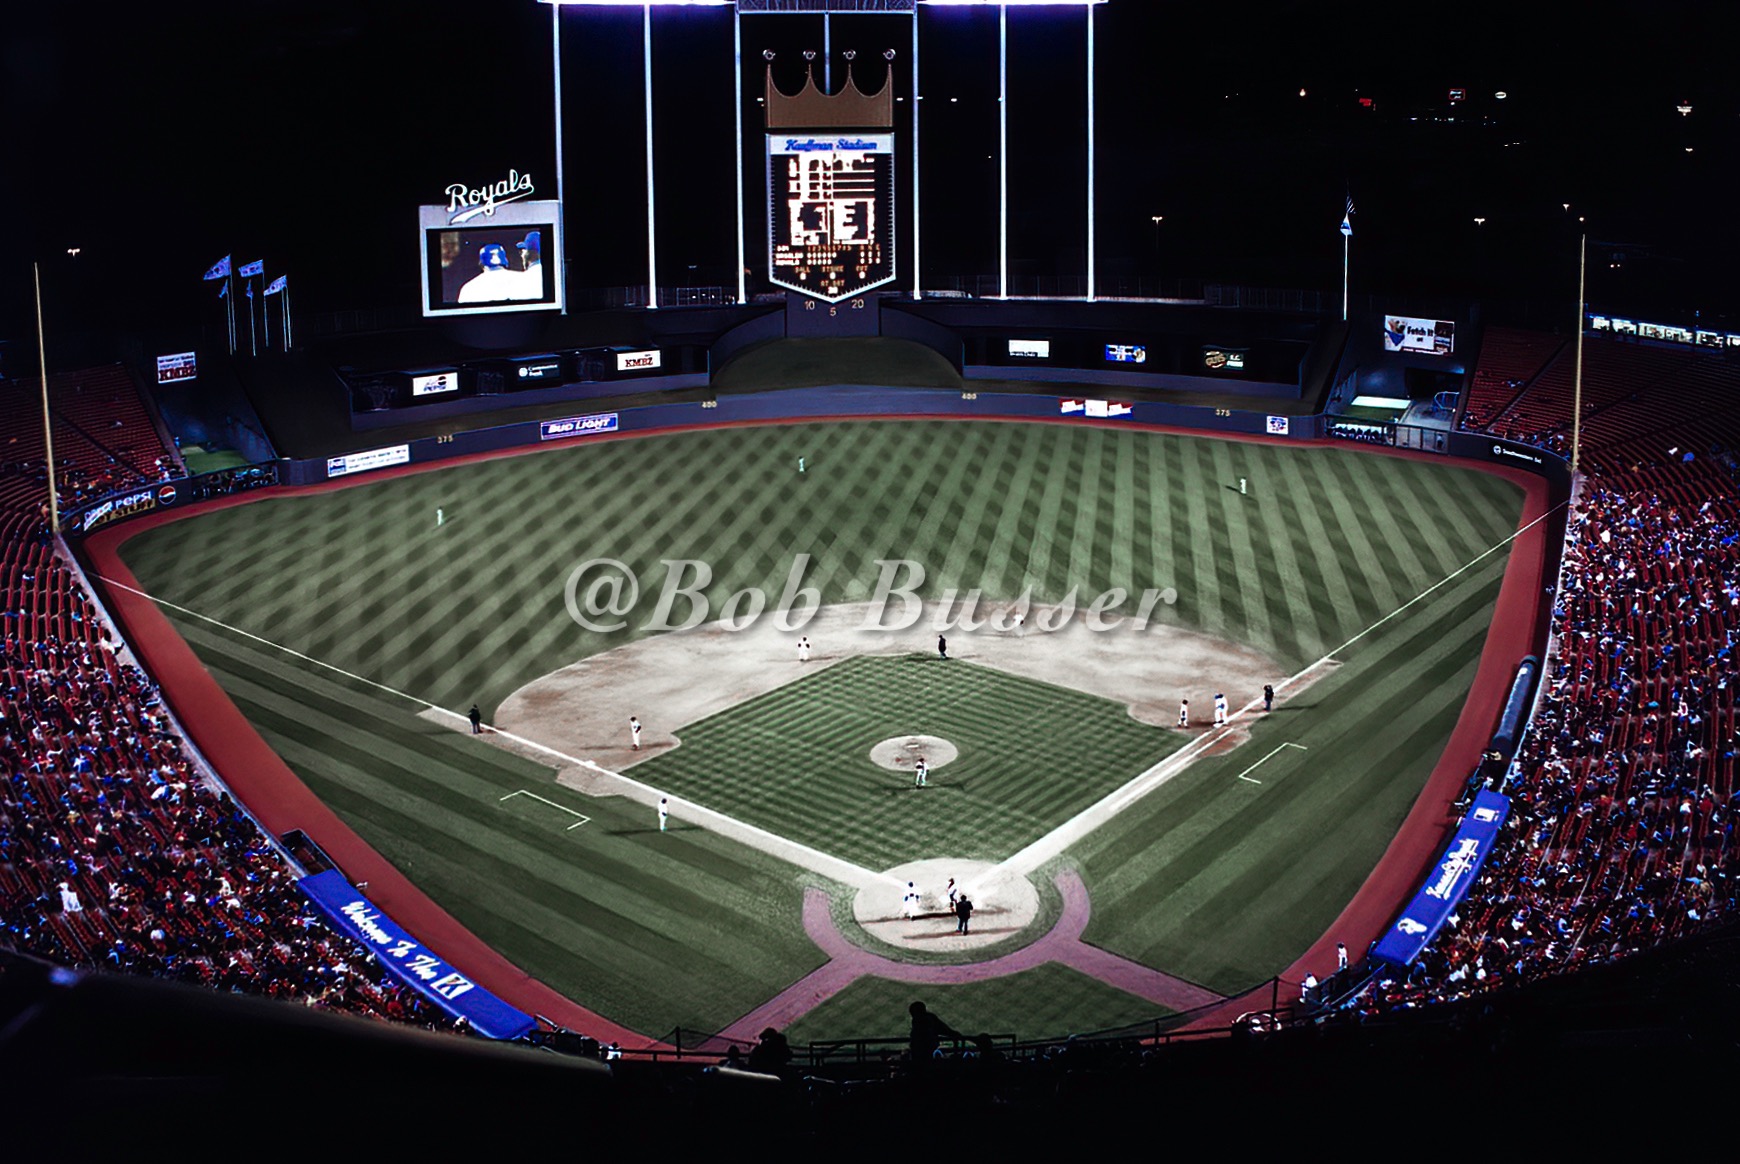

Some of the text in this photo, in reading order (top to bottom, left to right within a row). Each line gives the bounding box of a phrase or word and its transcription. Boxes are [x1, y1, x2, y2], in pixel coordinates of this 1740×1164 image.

[785, 138, 878, 152] Kauffman Stadium
[445, 169, 534, 217] Royals
[805, 300, 815, 310] 10
[851, 298, 865, 309] 20
[829, 307, 837, 316] 5
[1215, 408, 1231, 417] 375
[115, 491, 152, 509] PEPSI
[341, 901, 392, 944] Welcome
[387, 940, 417, 957] To
[405, 954, 440, 980] The
